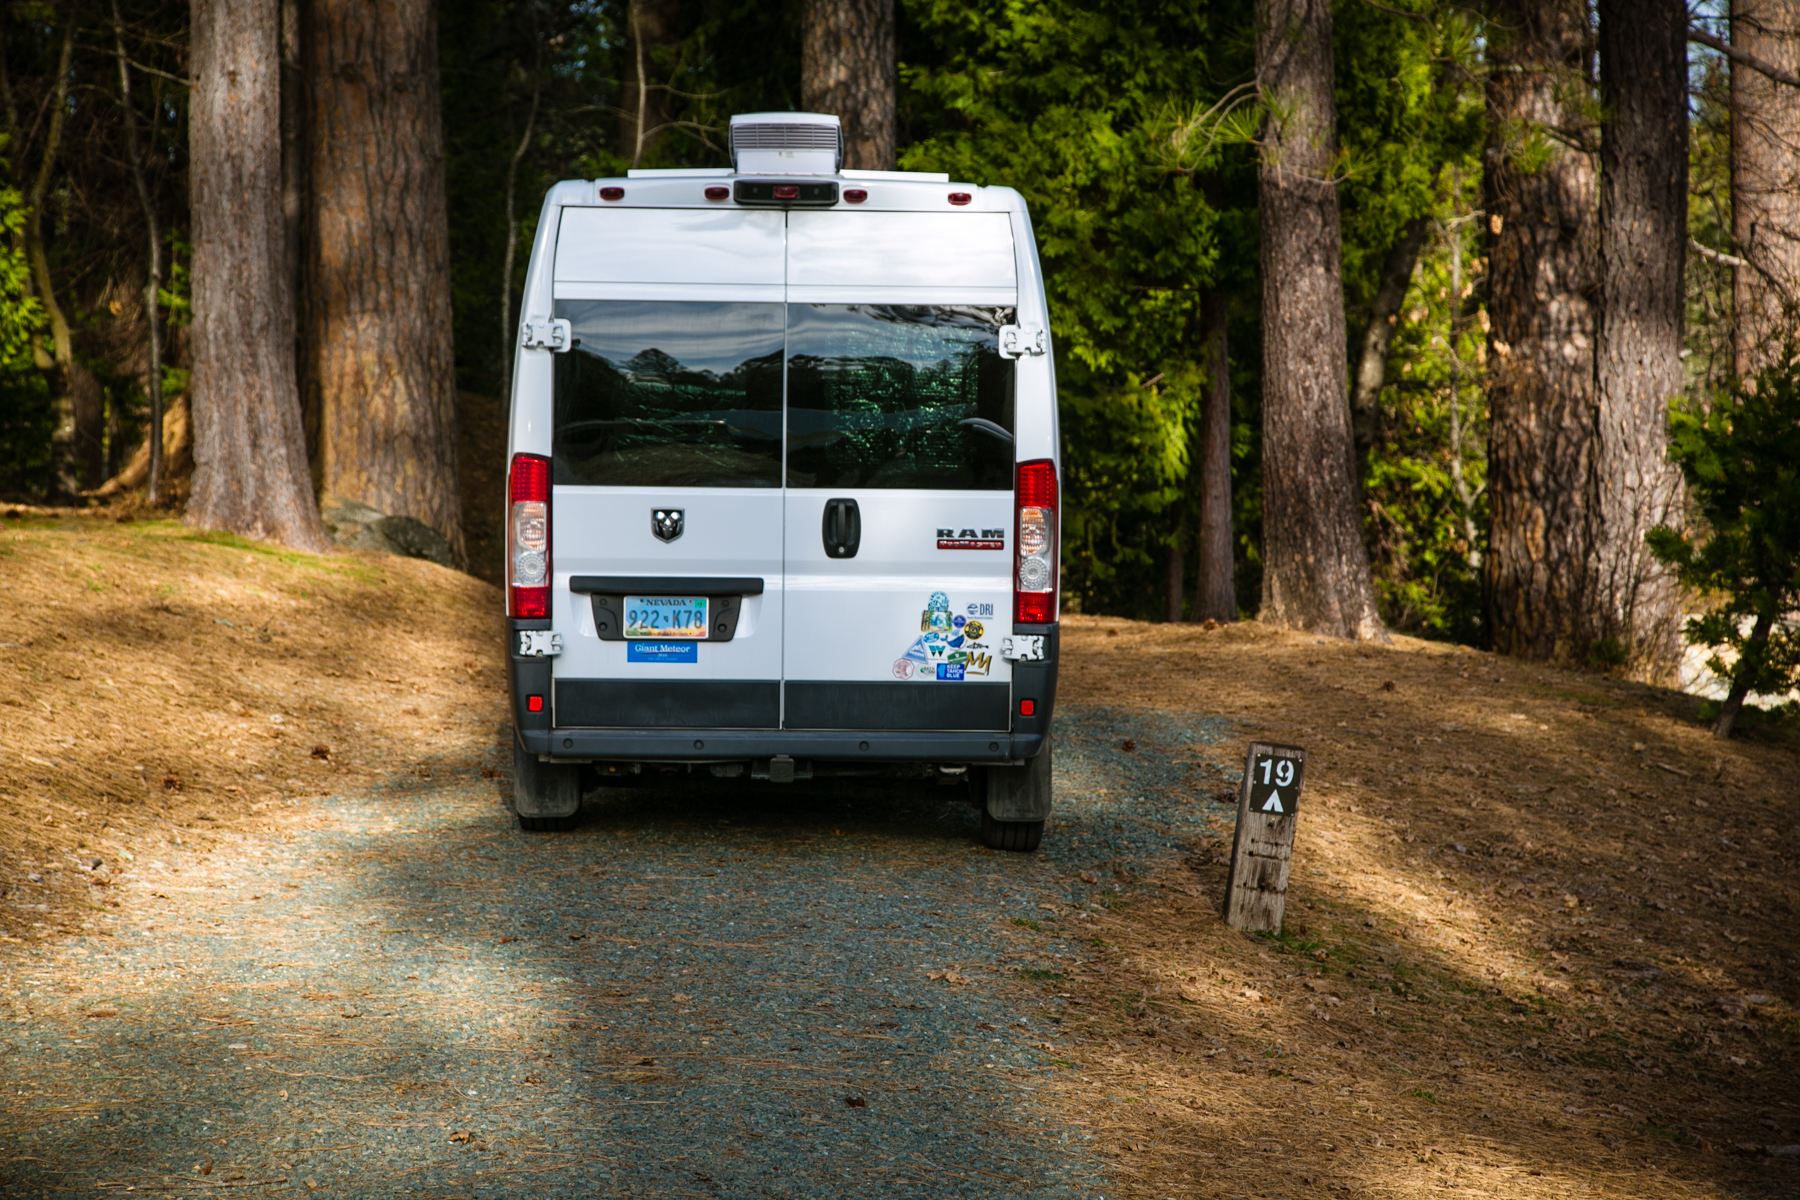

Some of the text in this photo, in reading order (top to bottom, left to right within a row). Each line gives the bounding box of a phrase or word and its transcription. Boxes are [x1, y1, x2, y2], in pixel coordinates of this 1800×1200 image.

[936, 528, 1004, 538] RAM
[979, 603, 993, 615] DRI
[629, 610, 703, 629] 922 K78
[634, 643, 690, 653] Giant Meteor
[1259, 758, 1294, 787] 19
